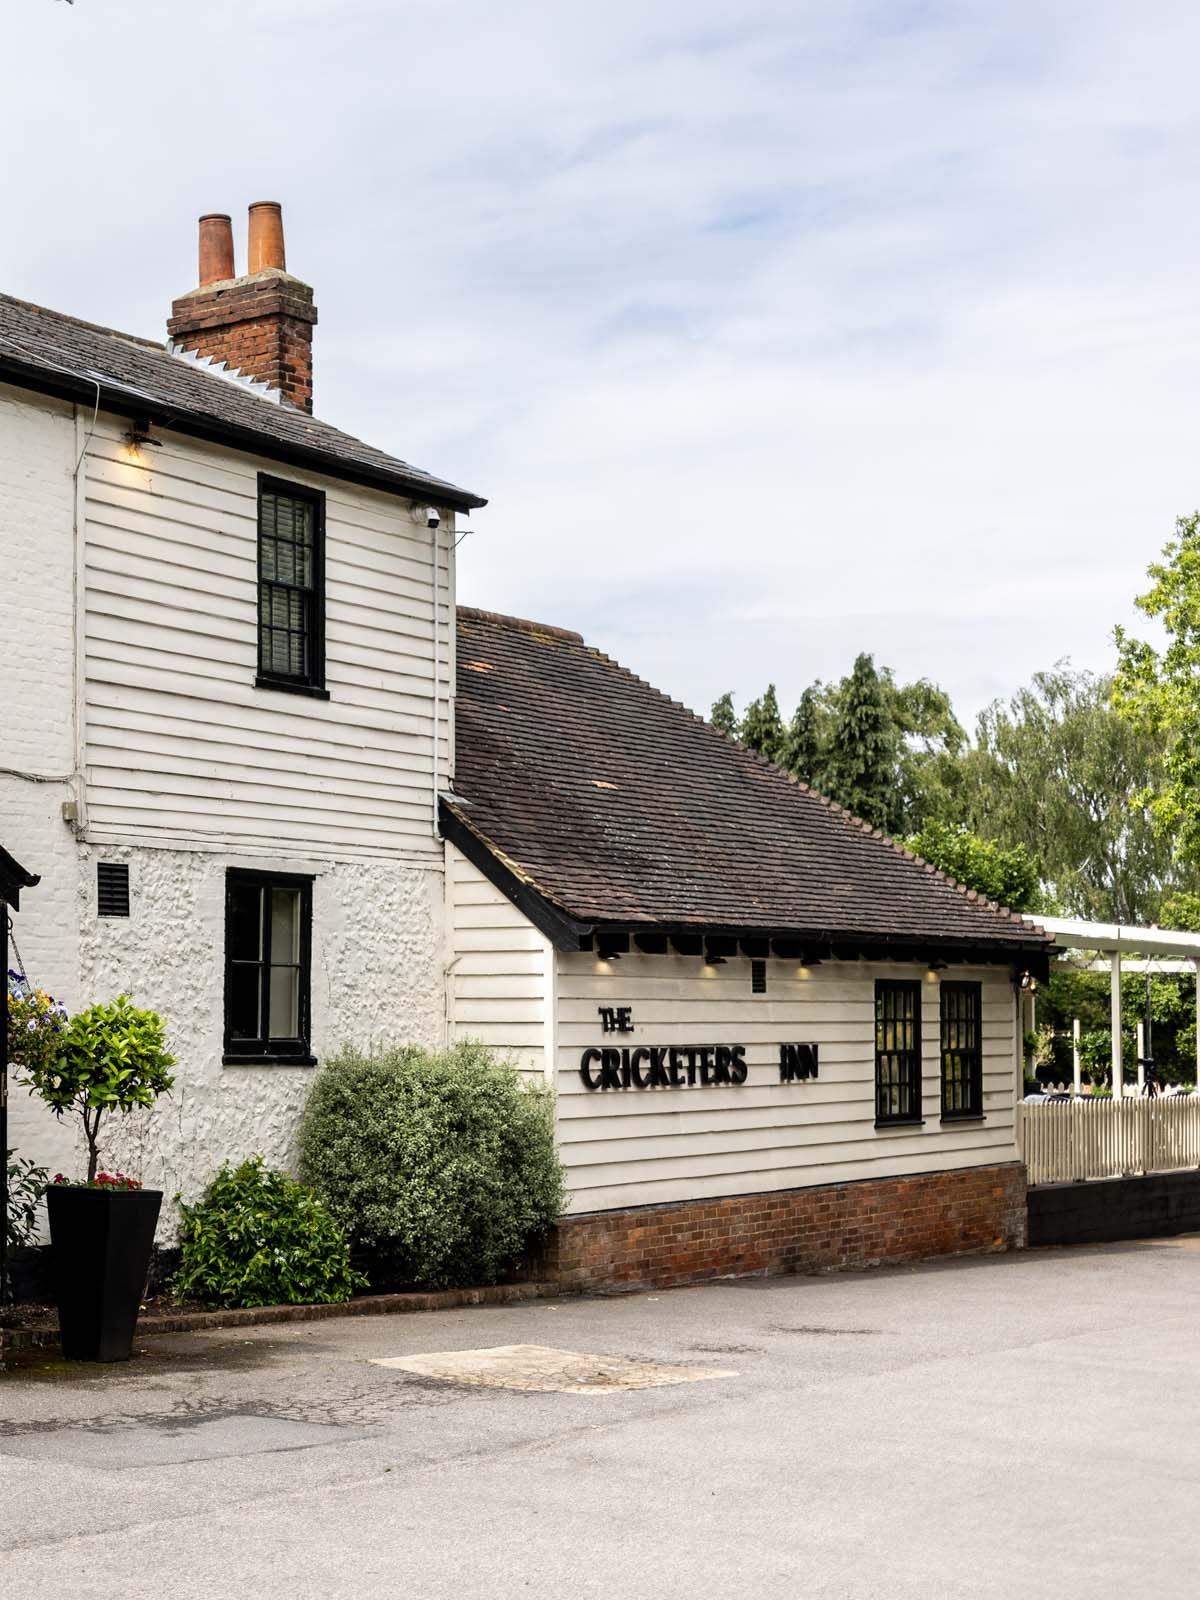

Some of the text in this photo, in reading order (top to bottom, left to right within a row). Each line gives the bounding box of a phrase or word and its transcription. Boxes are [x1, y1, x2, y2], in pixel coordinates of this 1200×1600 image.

[598, 1007, 634, 1032] THE
[580, 1044, 819, 1089] CRICKETERS INN
